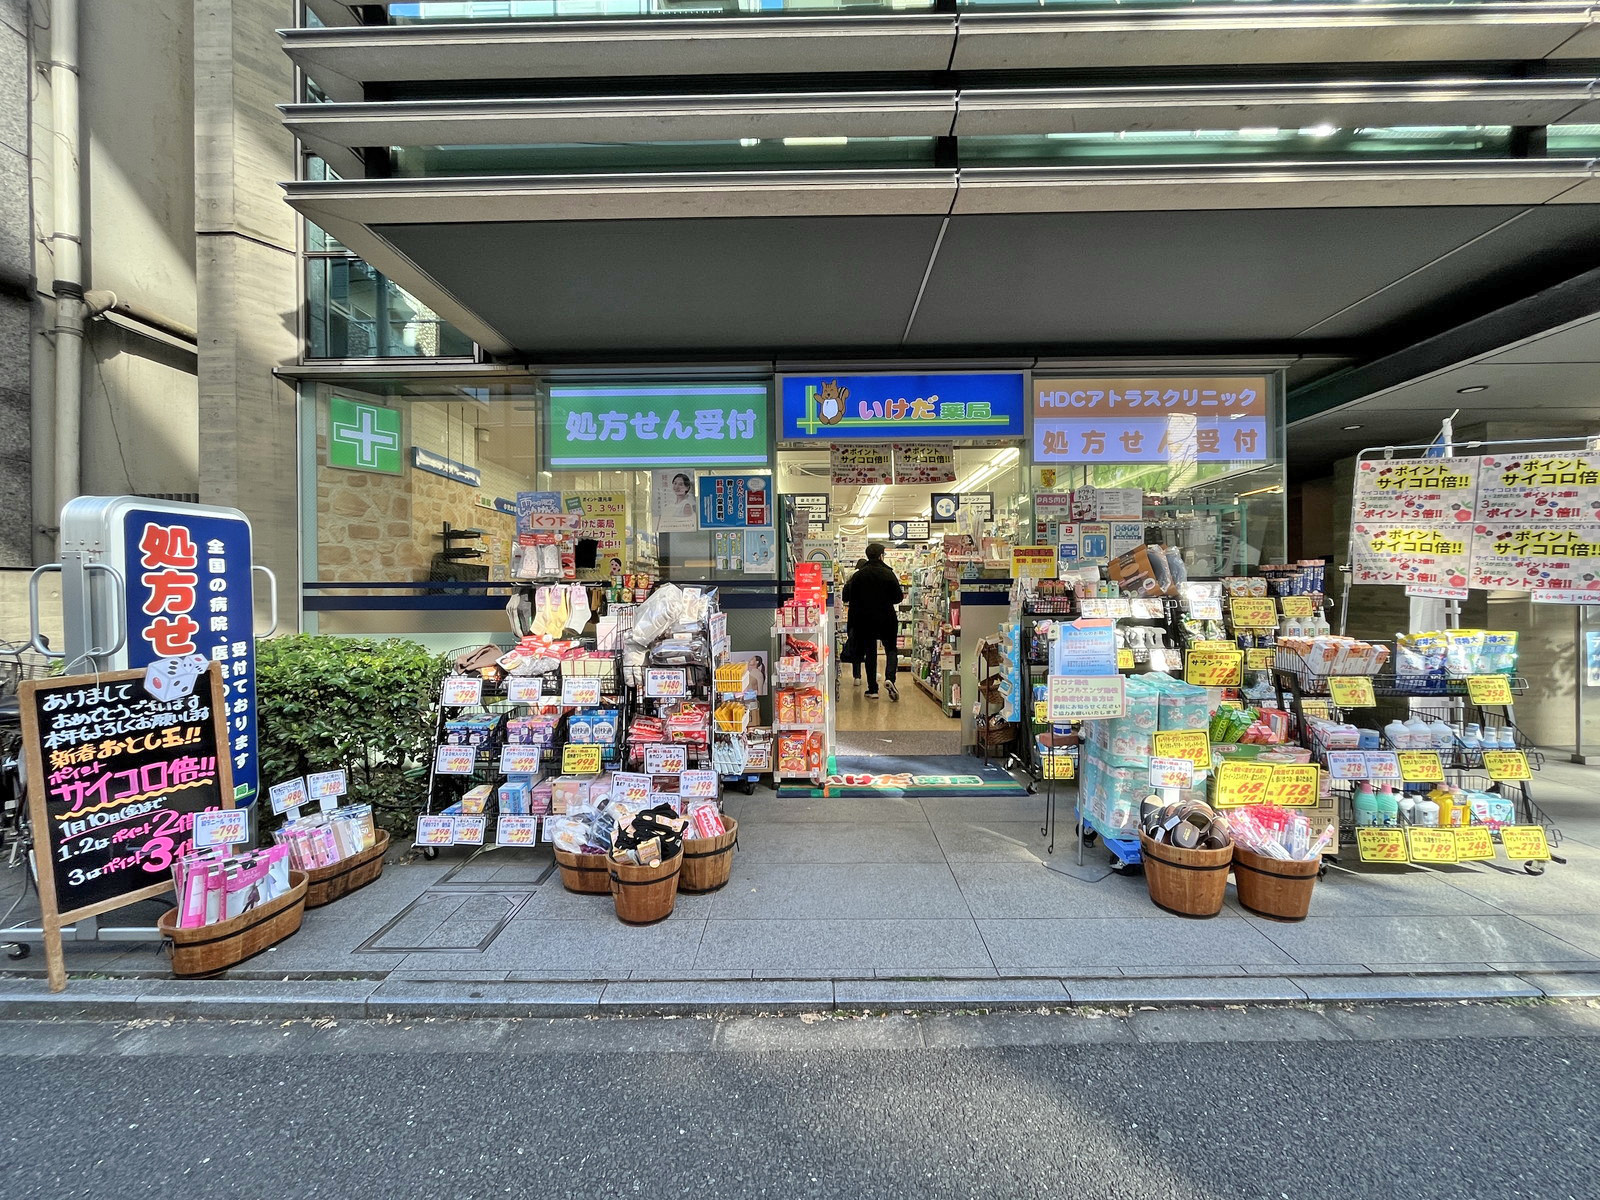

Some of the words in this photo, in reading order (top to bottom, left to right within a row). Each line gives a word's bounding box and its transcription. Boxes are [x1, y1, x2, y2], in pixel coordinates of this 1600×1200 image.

[1039, 388, 1257, 408] HDCアトラスクリニック
[858, 394, 993, 421] いけだ薬局
[566, 408, 758, 442] 処方せん受付
[849, 448, 878, 456] ポイント
[912, 447, 940, 455] ポイント
[841, 456, 889, 464] サイコロ倍!!
[903, 455, 951, 464] サイコロ倍!!
[1395, 465, 1448, 476] ポイント
[1523, 460, 1587, 472] ポイント
[1377, 476, 1469, 489] サイコロ倍!!
[1037, 496, 1066, 504] PASMO
[1364, 509, 1443, 519] ポイント3倍!!
[1486, 508, 1580, 518] ポイント3倍!!
[535, 515, 567, 527] くつ下
[1389, 531, 1442, 540] ポイント
[1515, 532, 1578, 542] ポイント
[1371, 541, 1462, 554] サイコロ倍!!
[1494, 543, 1600, 557] サイコロ倍!!
[1360, 571, 1437, 583] ポイント3倍!!
[1479, 575, 1572, 588] ポイント3倍!!
[139, 522, 199, 657] 処方せ
[1250, 612, 1272, 620] 98
[1208, 668, 1237, 678] 128
[663, 681, 680, 690] 1480
[43, 684, 134, 712] あけまして
[459, 690, 476, 699] 798
[1484, 689, 1505, 697] 358
[231, 640, 249, 770] 受付ております
[51, 695, 201, 729] おめでとうございます
[44, 706, 211, 750] 本年もよろしくお願いします
[49, 726, 202, 771] 新春おとし玉!!
[1178, 749, 1204, 759] 398
[661, 760, 682, 768] 348
[1347, 762, 1362, 772] 278
[1378, 762, 1393, 772] 248
[1502, 764, 1523, 772] 218
[48, 761, 107, 786] ポイント
[1419, 765, 1437, 774] 398
[1168, 773, 1188, 781] 698
[51, 755, 216, 812] サイコロ倍!!
[695, 782, 711, 791] 198
[1236, 782, 1264, 794] 68
[626, 789, 647, 798] 398
[1276, 784, 1311, 796] 128
[58, 797, 169, 839] 1月10日(金)まで
[219, 824, 239, 836] 798
[464, 828, 478, 837] 398
[1376, 844, 1400, 853] 78
[1429, 844, 1451, 854] 189
[1467, 842, 1487, 852] 248
[1520, 843, 1541, 851] 278
